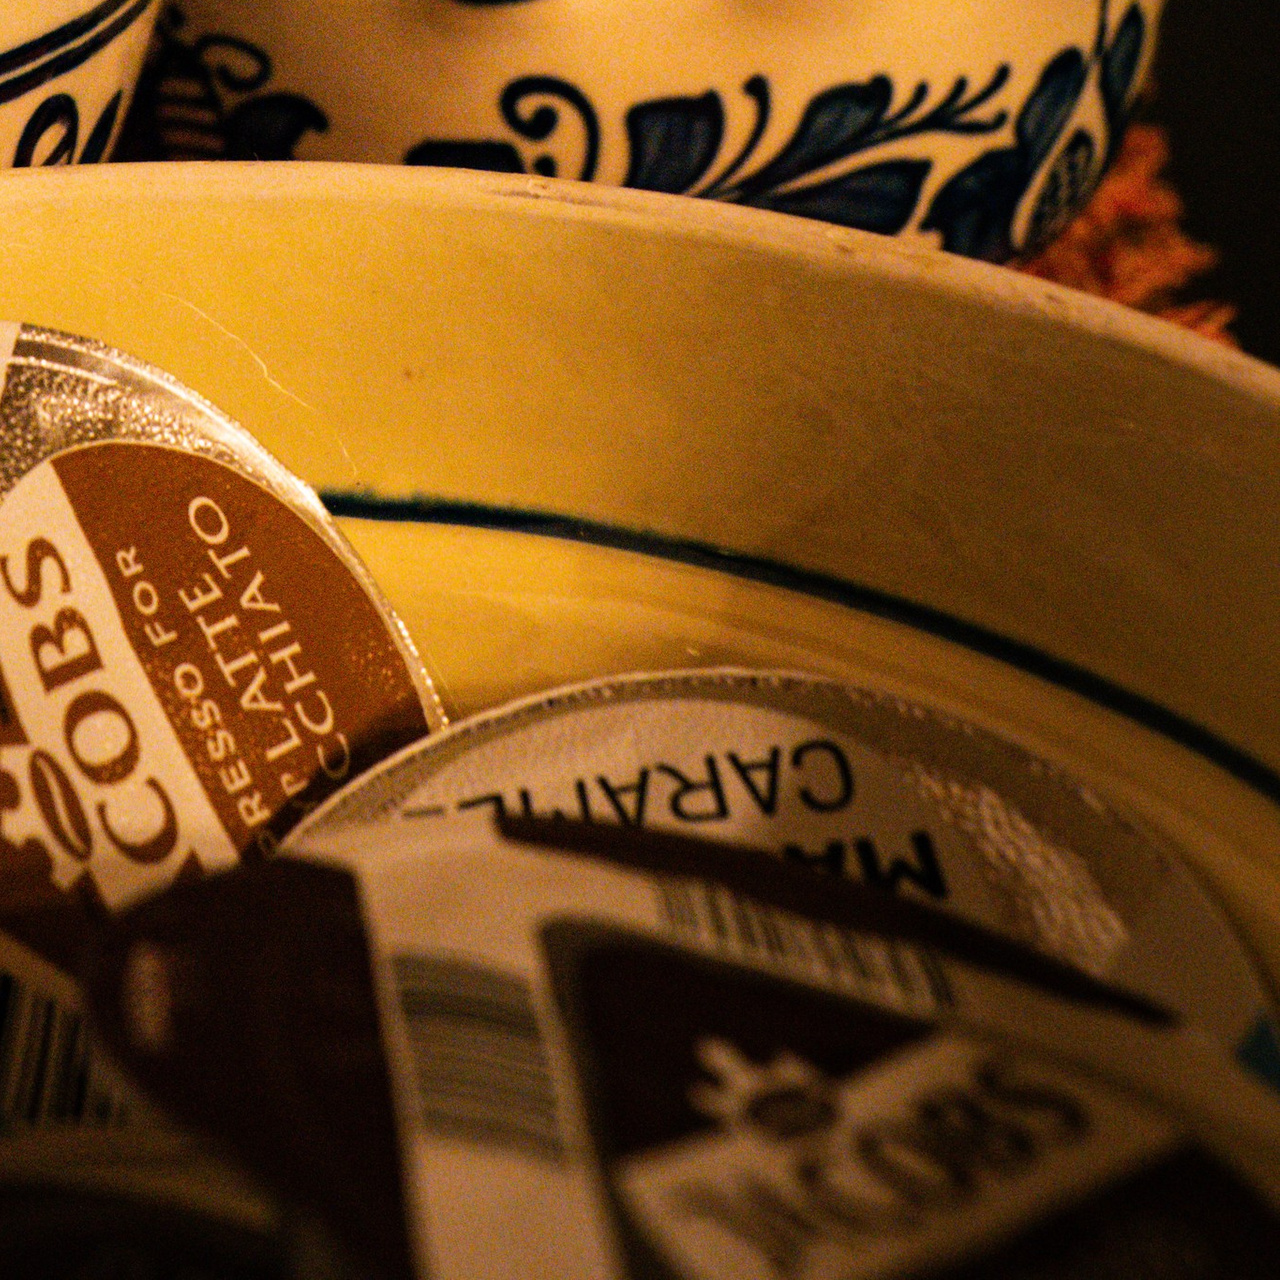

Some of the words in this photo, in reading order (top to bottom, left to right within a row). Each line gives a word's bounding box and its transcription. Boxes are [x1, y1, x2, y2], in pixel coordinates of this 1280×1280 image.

[115, 544, 178, 648] FOR
[178, 571, 303, 763] LATTE
[187, 495, 350, 780] CCHIATO
[173, 661, 272, 831] RESSO
